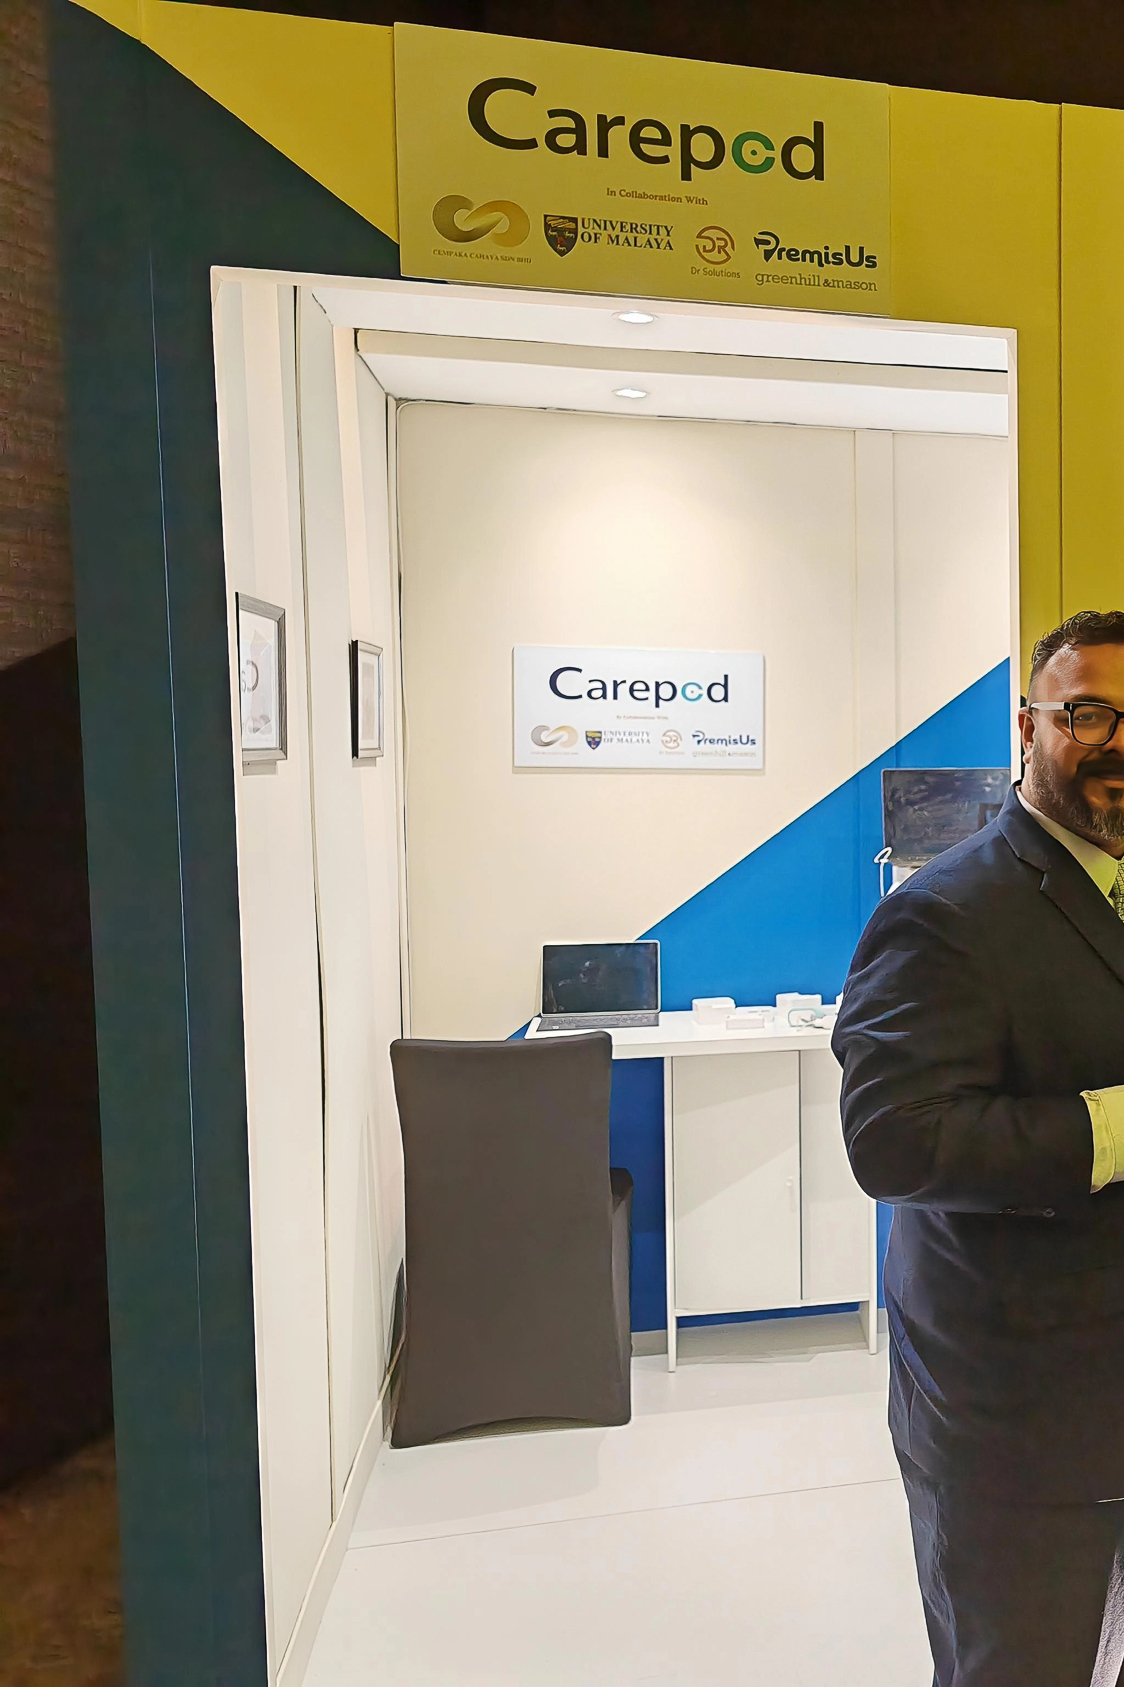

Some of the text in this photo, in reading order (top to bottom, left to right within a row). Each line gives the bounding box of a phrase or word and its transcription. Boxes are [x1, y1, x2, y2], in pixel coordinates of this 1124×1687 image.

[607, 188, 708, 205] In Collaboration With
[581, 218, 674, 237] UNIVERSITY
[581, 232, 674, 250] OF MALAYA
[433, 249, 468, 258] CEMPAKA
[470, 252, 499, 261] CAHAYA
[754, 231, 878, 269] PremisUs
[691, 266, 741, 279] Dr Solutions
[755, 272, 821, 288] greenhill
[692, 730, 756, 746] PremisUs
